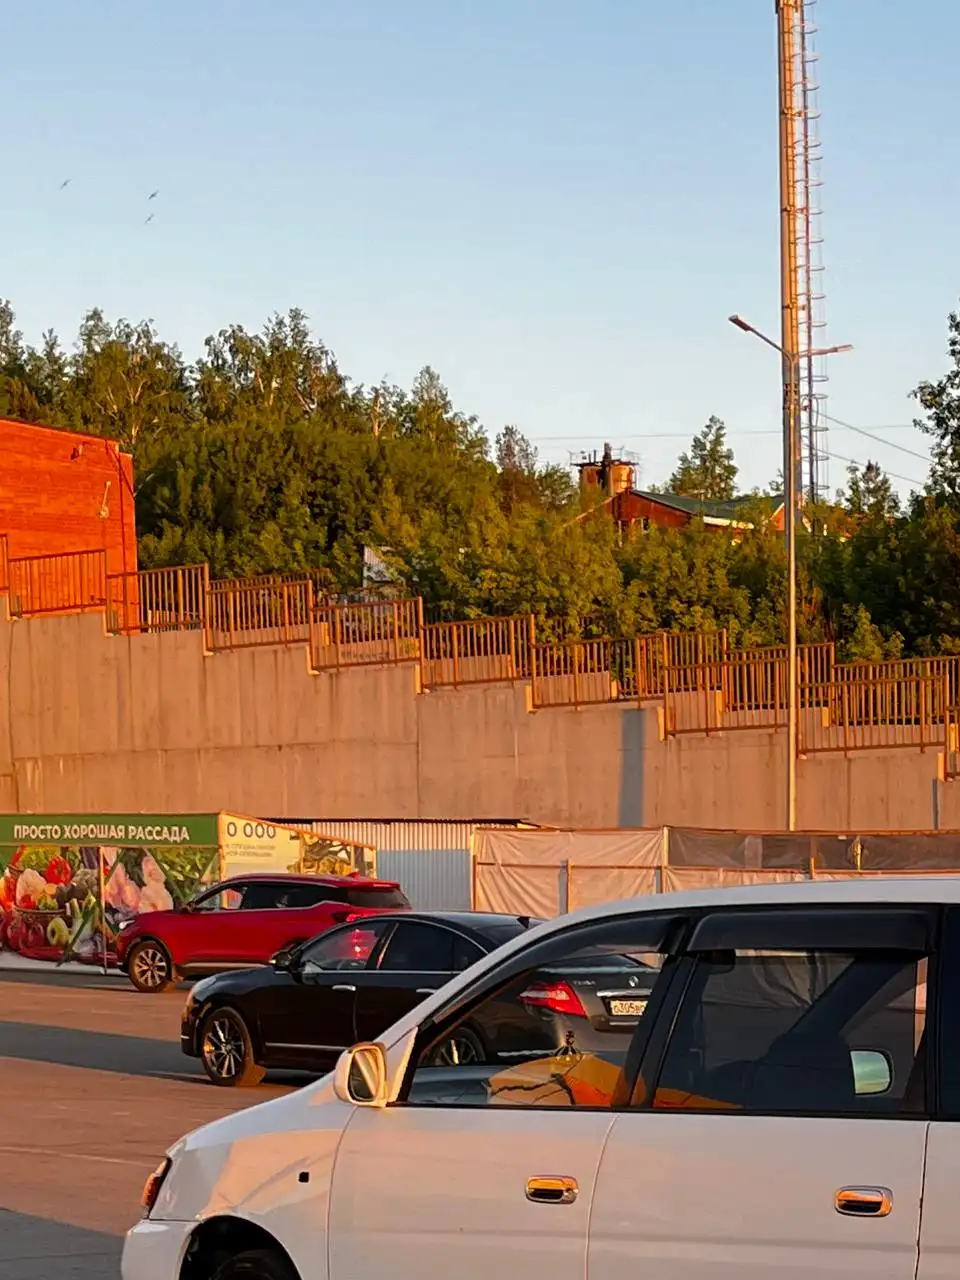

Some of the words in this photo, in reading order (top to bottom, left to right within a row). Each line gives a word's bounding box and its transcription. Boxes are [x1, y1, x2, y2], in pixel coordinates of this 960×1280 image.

[13, 824, 61, 839] ПРОСТО
[63, 824, 125, 839] ХОРОШАЯ
[128, 825, 190, 843] РАССАДА
